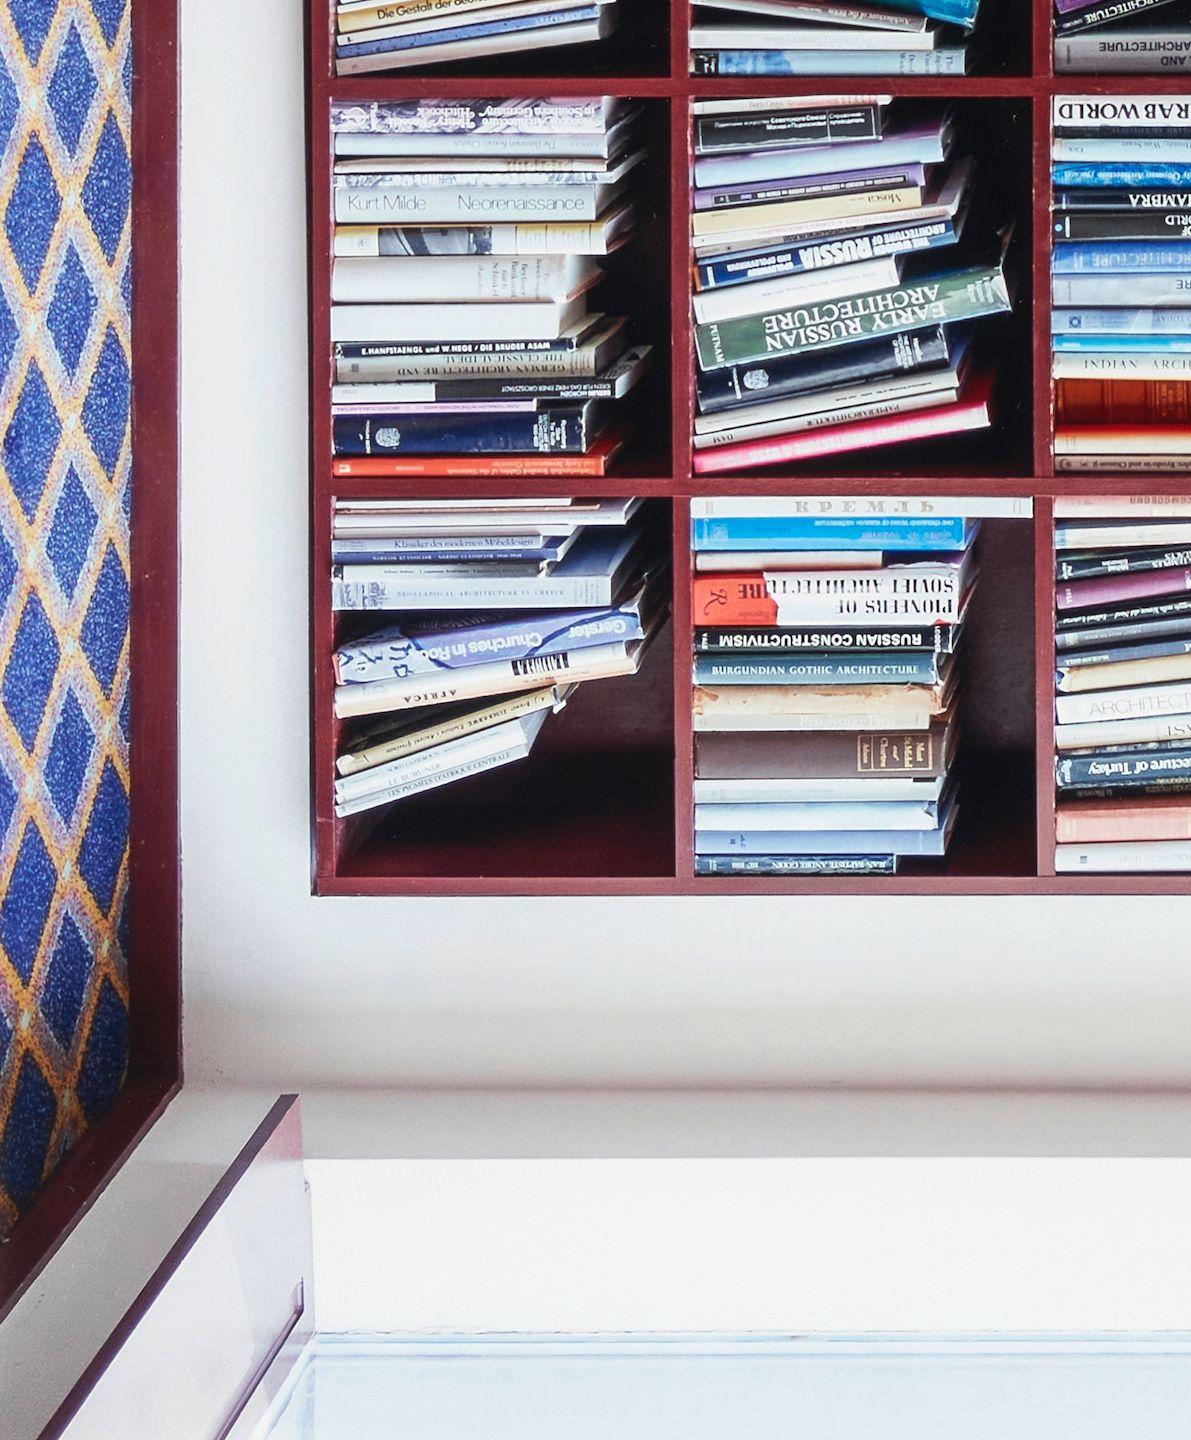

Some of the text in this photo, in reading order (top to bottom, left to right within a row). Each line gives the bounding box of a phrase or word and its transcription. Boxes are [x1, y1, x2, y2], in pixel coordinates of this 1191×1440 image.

[377, 8, 393, 20] Die
[396, 0, 432, 17] Gestalt
[434, 0, 451, 10] der
[1099, 42, 1191, 51] ARCHITECTURE
[1161, 55, 1186, 65] AND
[1059, 104, 1139, 119] WORLD
[348, 194, 584, 211] Kurt Milde Neorenaissance
[867, 193, 901, 204] Mosca
[762, 284, 940, 334] ARCHITECTURE
[765, 301, 945, 351] EARLY RUSSIAN
[892, 579, 953, 594] SOVIET
[835, 599, 953, 614] PIONEERS OF
[452, 619, 626, 656] Gerster Churches in
[720, 634, 921, 646] RUSSIAN CONSTRUCTIVISM
[712, 666, 917, 675] BURGUNDIAN GOTHIC ARCHITECTURE
[403, 689, 457, 703] AFRICA
[1088, 760, 1131, 775] Turkey
[1135, 761, 1148, 772] of
